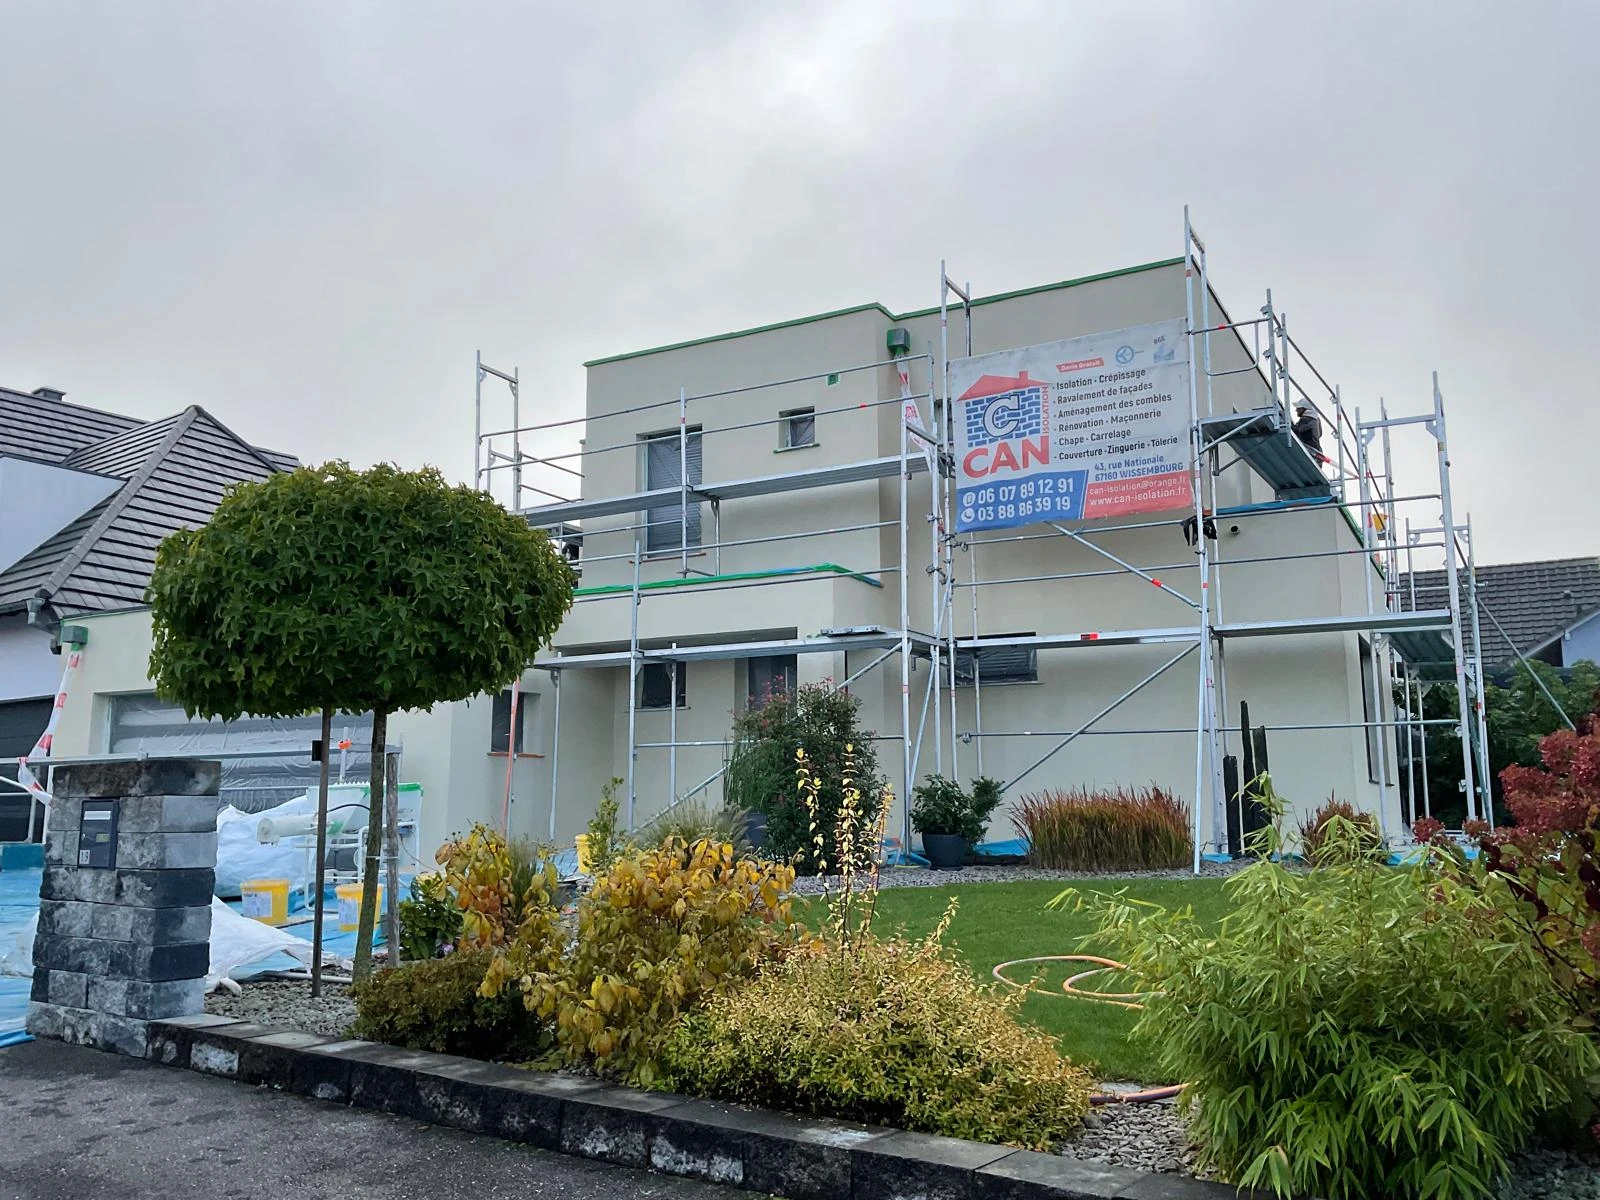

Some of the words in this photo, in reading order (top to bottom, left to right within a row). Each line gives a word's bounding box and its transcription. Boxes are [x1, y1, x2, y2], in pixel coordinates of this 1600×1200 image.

[1056, 377, 1092, 390] Isolation
[1099, 369, 1146, 384] Crépissage
[1057, 390, 1105, 404] Ravalement
[1107, 388, 1117, 398] de
[1120, 382, 1153, 396] façades
[983, 393, 1020, 438] C
[1042, 385, 1050, 434] ISOLATION
[1058, 402, 1116, 418] Aménagement
[1118, 400, 1134, 409] des
[1136, 393, 1172, 405] combles
[1059, 419, 1104, 432] Rénovation
[1110, 409, 1162, 424] Maçonnerie
[1058, 437, 1084, 446] Chape
[1090, 428, 1132, 442] Carrelage
[1059, 447, 1103, 460] Couverture
[1108, 441, 1146, 454] Zinguerie
[1151, 436, 1178, 448] Tôlerie
[963, 436, 1050, 479] CAN
[1094, 463, 1106, 472] 43,
[1108, 462, 1122, 470] rue
[1124, 455, 1164, 467] Nationale
[1094, 471, 1118, 481] 67160
[1120, 462, 1184, 478] WISSEMBOURG
[978, 488, 994, 504] 06
[1000, 485, 1016, 502] 07
[1020, 481, 1034, 498] 89
[1038, 479, 1054, 494] 12
[1058, 478, 1074, 493] 91
[1090, 476, 1186, 495] can-isolation@orange.fr
[1090, 486, 1186, 506] www.can-isolation.fr
[978, 506, 994, 520] 03
[998, 504, 1015, 519] 88
[1018, 502, 1032, 516] 86
[1035, 497, 1050, 512] 39
[1055, 496, 1070, 510] 19
[80, 851, 88, 862] 19
